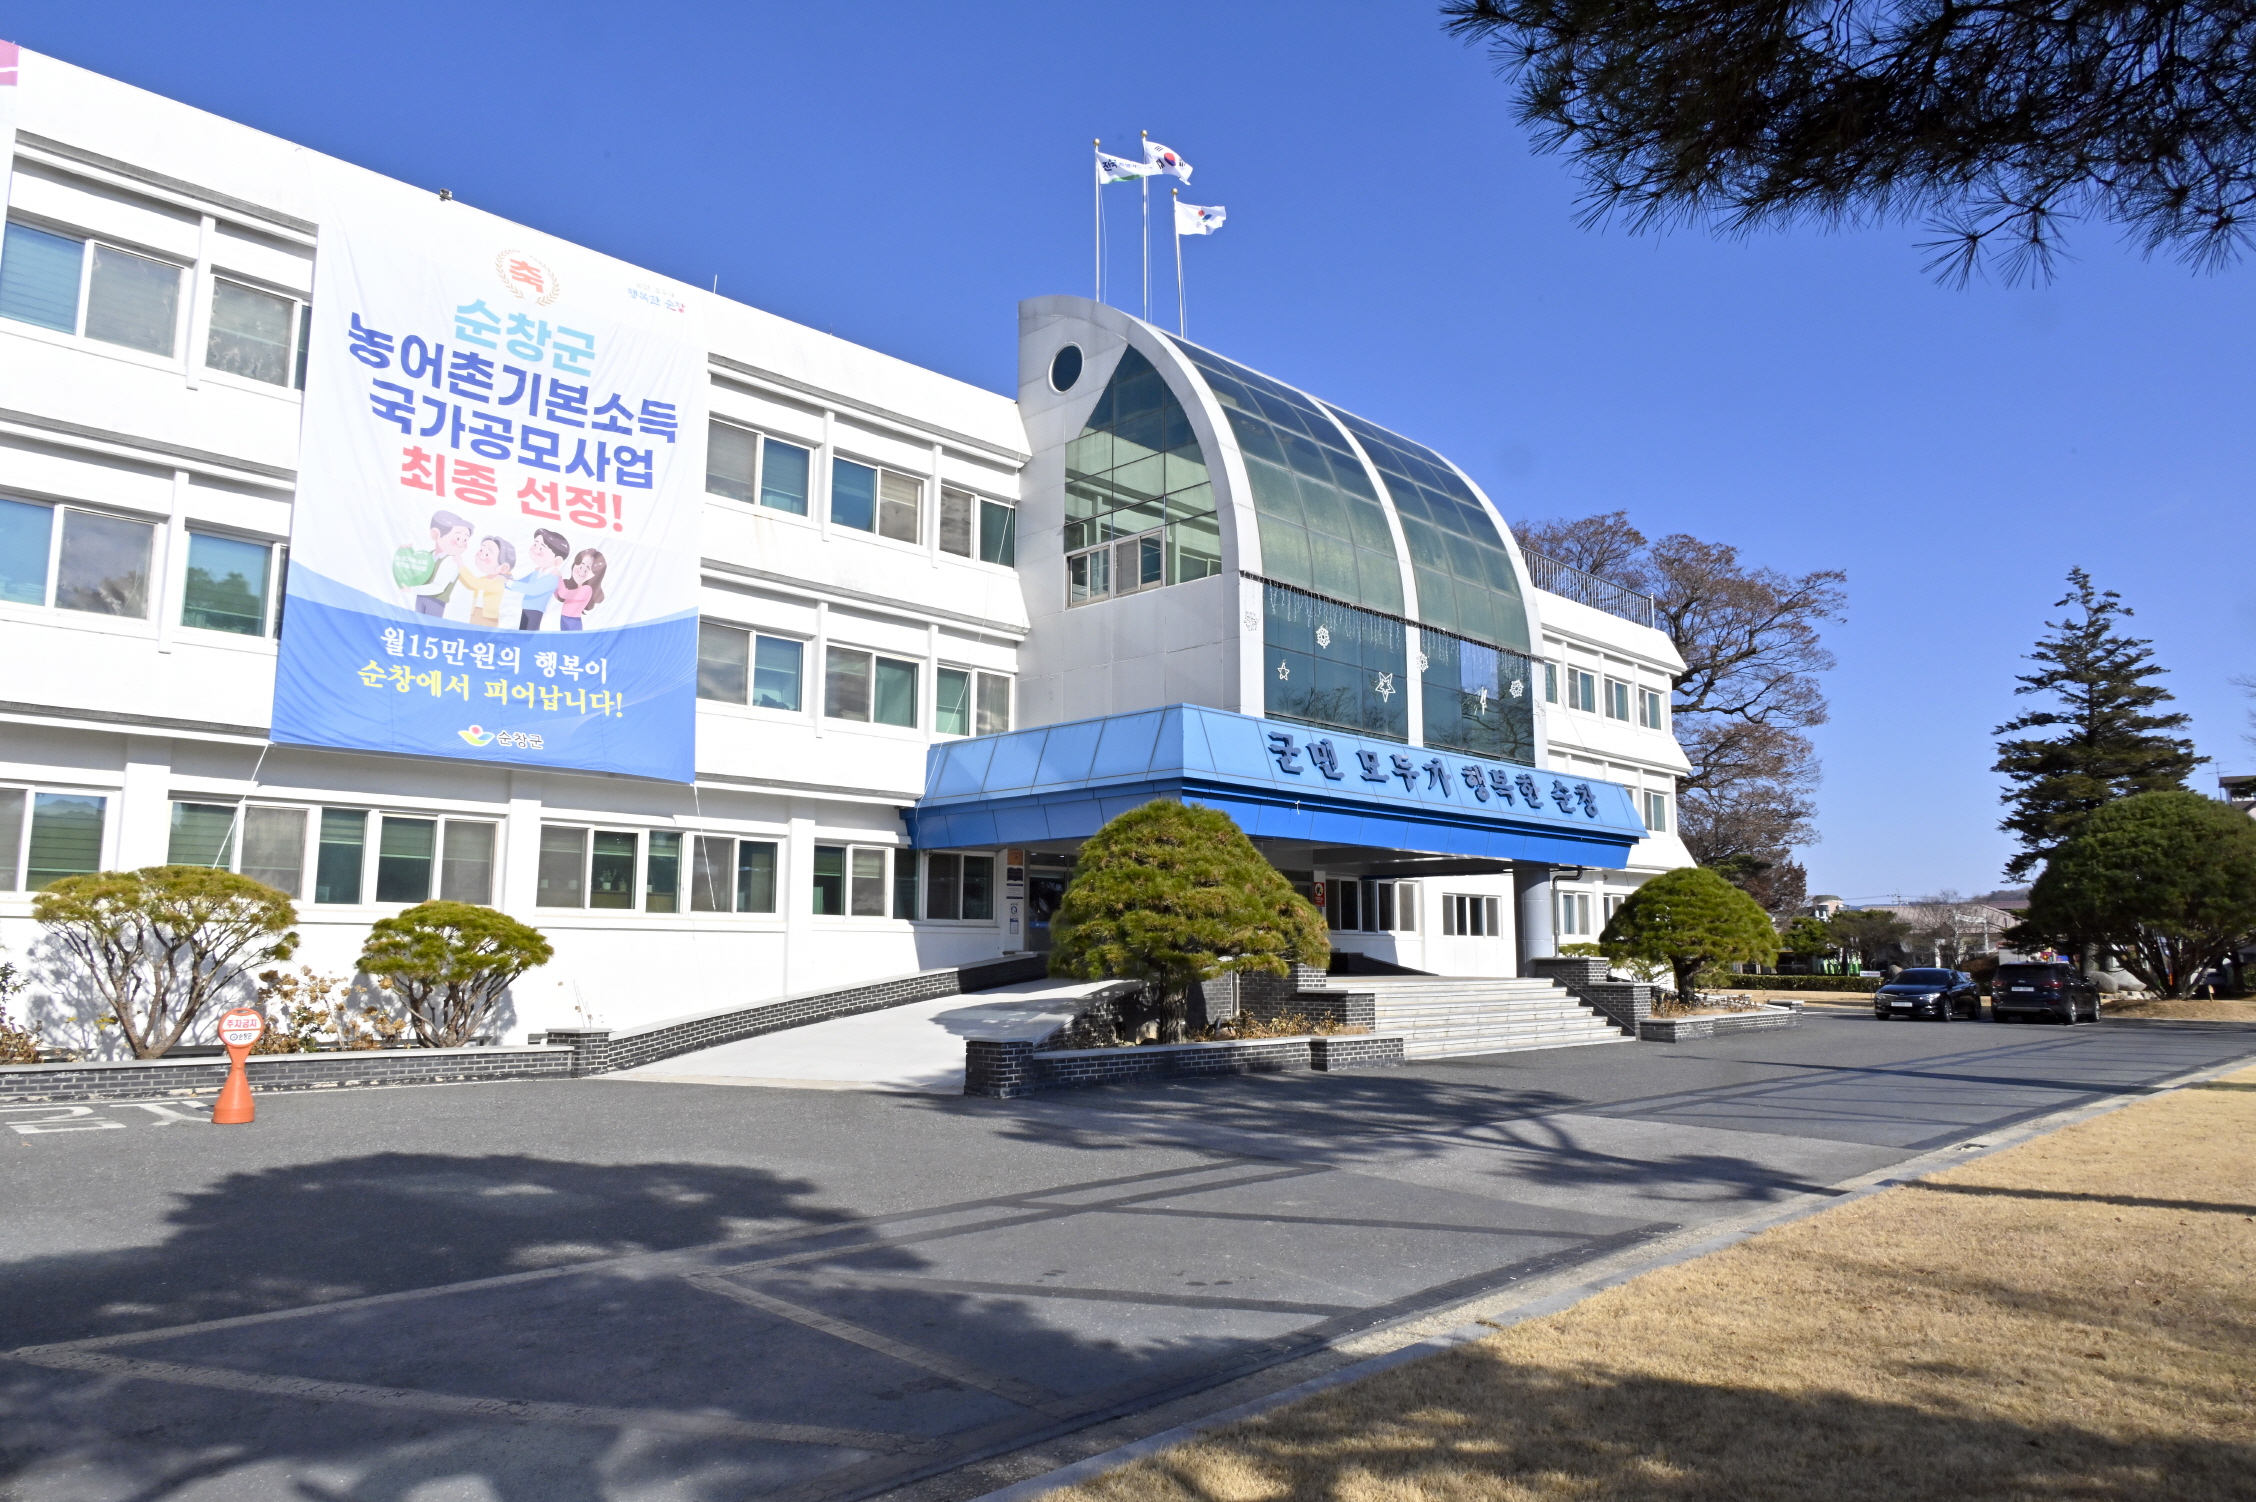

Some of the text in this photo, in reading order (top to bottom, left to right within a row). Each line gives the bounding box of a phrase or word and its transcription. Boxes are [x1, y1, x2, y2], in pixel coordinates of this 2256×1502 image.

[509, 258, 544, 293] 축
[627, 287, 686, 313] 행복한 순창
[454, 299, 596, 377] 순창군
[348, 312, 678, 443] 농어촌기본소득
[369, 378, 653, 489] 국가공모사업
[400, 445, 623, 532] 최종 선정!
[380, 626, 608, 684] 월15만원의 행복이
[357, 659, 624, 718] 순창에서 피어납니다!
[497, 730, 544, 749] 순창군
[1268, 731, 1600, 818] 군민 모두가 행복한 순창
[227, 1019, 257, 1028] 주차금지
